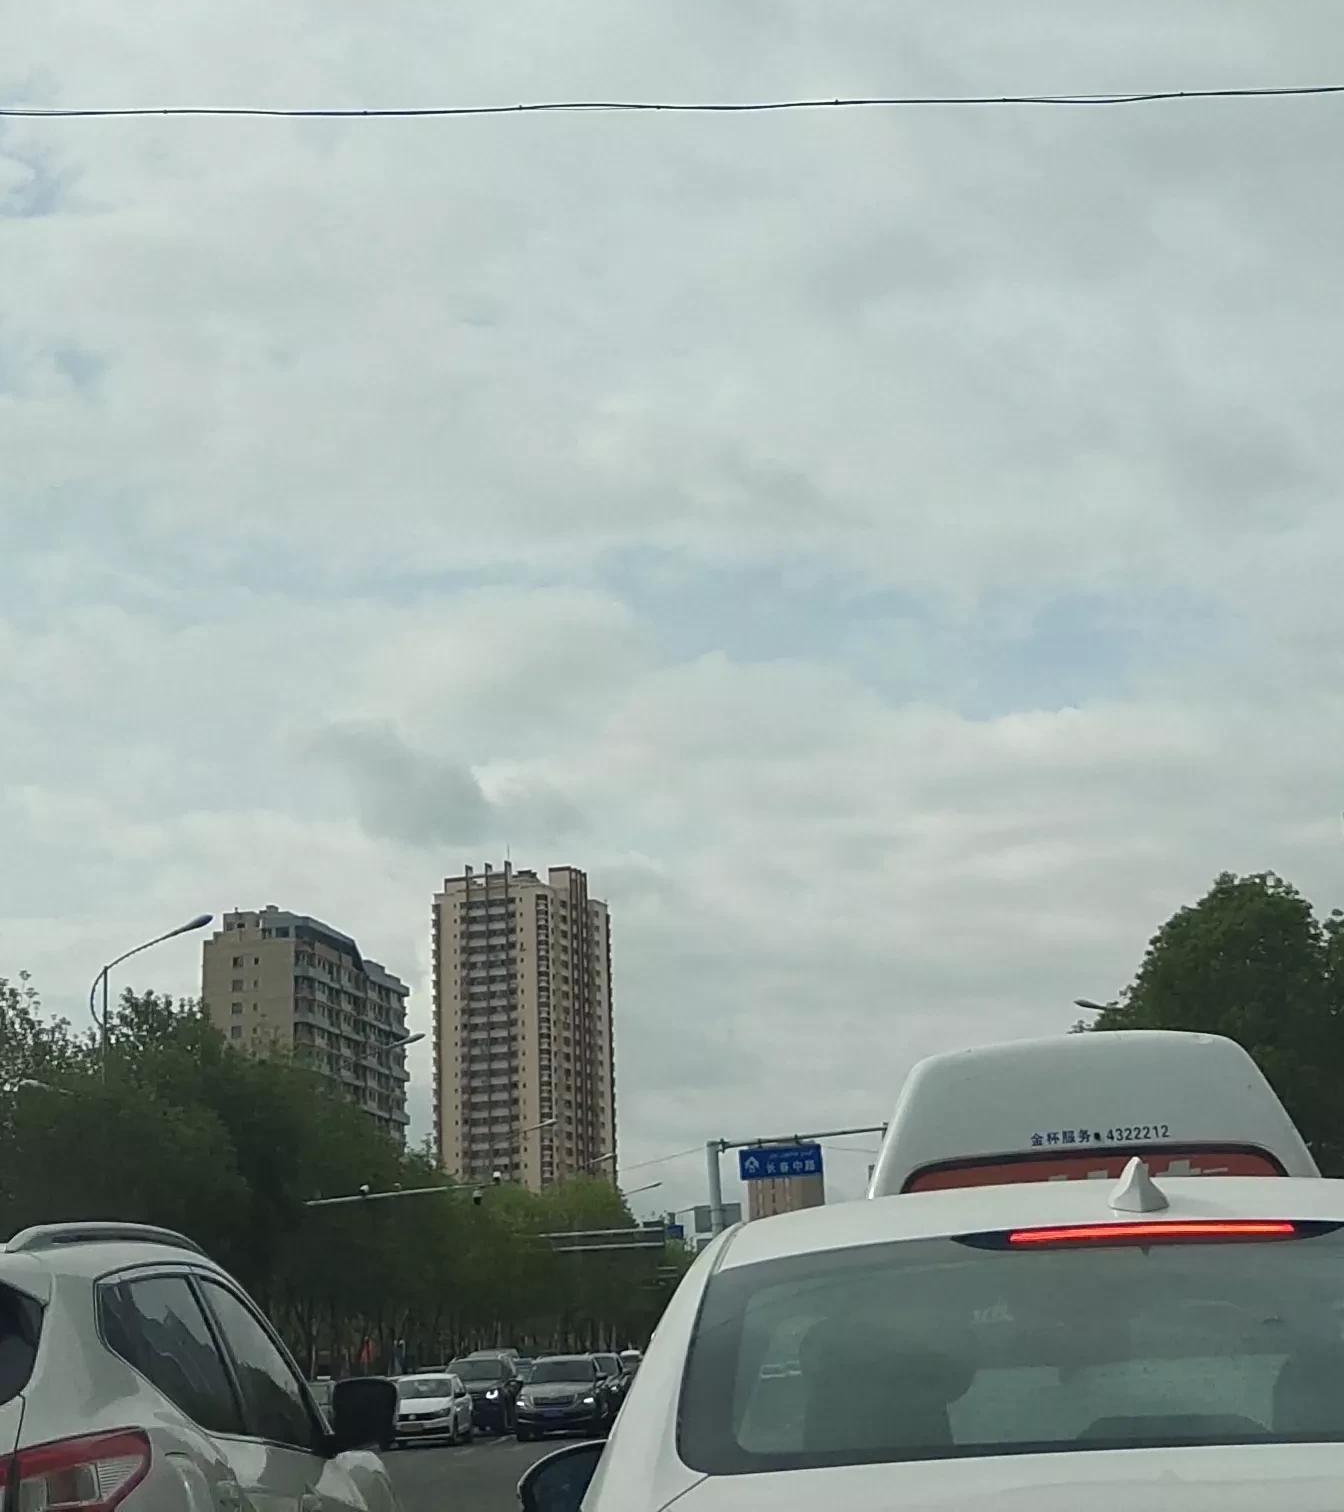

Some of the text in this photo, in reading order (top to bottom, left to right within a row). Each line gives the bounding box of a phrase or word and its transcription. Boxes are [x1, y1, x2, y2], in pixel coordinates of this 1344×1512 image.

[1030, 1124, 1171, 1147] 金杯服务 4322212
